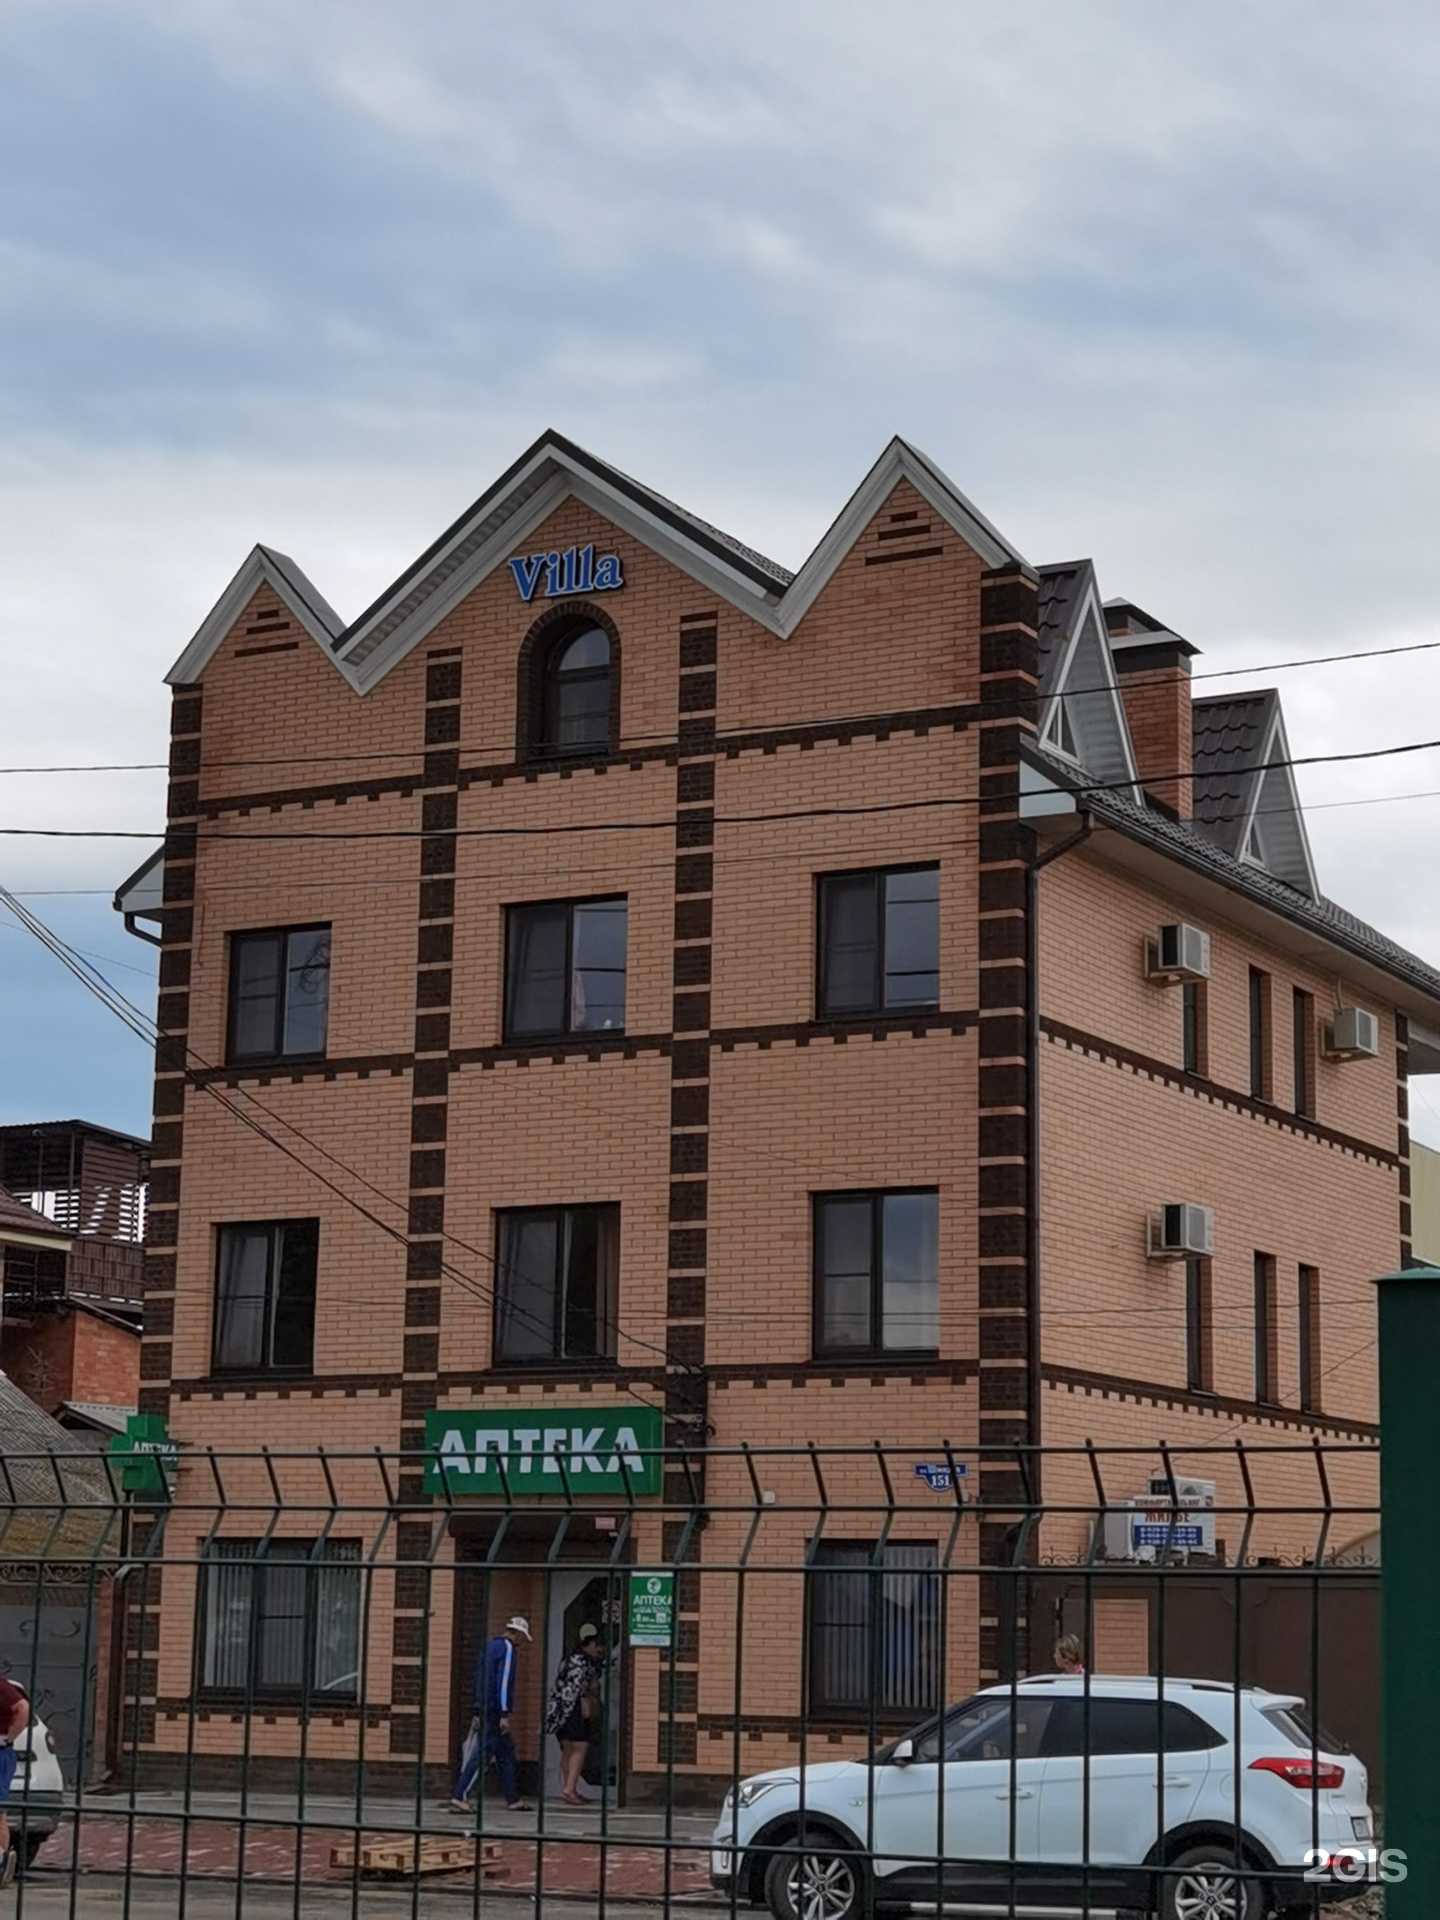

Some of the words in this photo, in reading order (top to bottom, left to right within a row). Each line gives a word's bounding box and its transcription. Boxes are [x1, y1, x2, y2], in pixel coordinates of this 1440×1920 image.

[509, 543, 623, 600] Villa
[433, 1427, 644, 1474] АПТЕКА
[931, 1474, 950, 1486] 151
